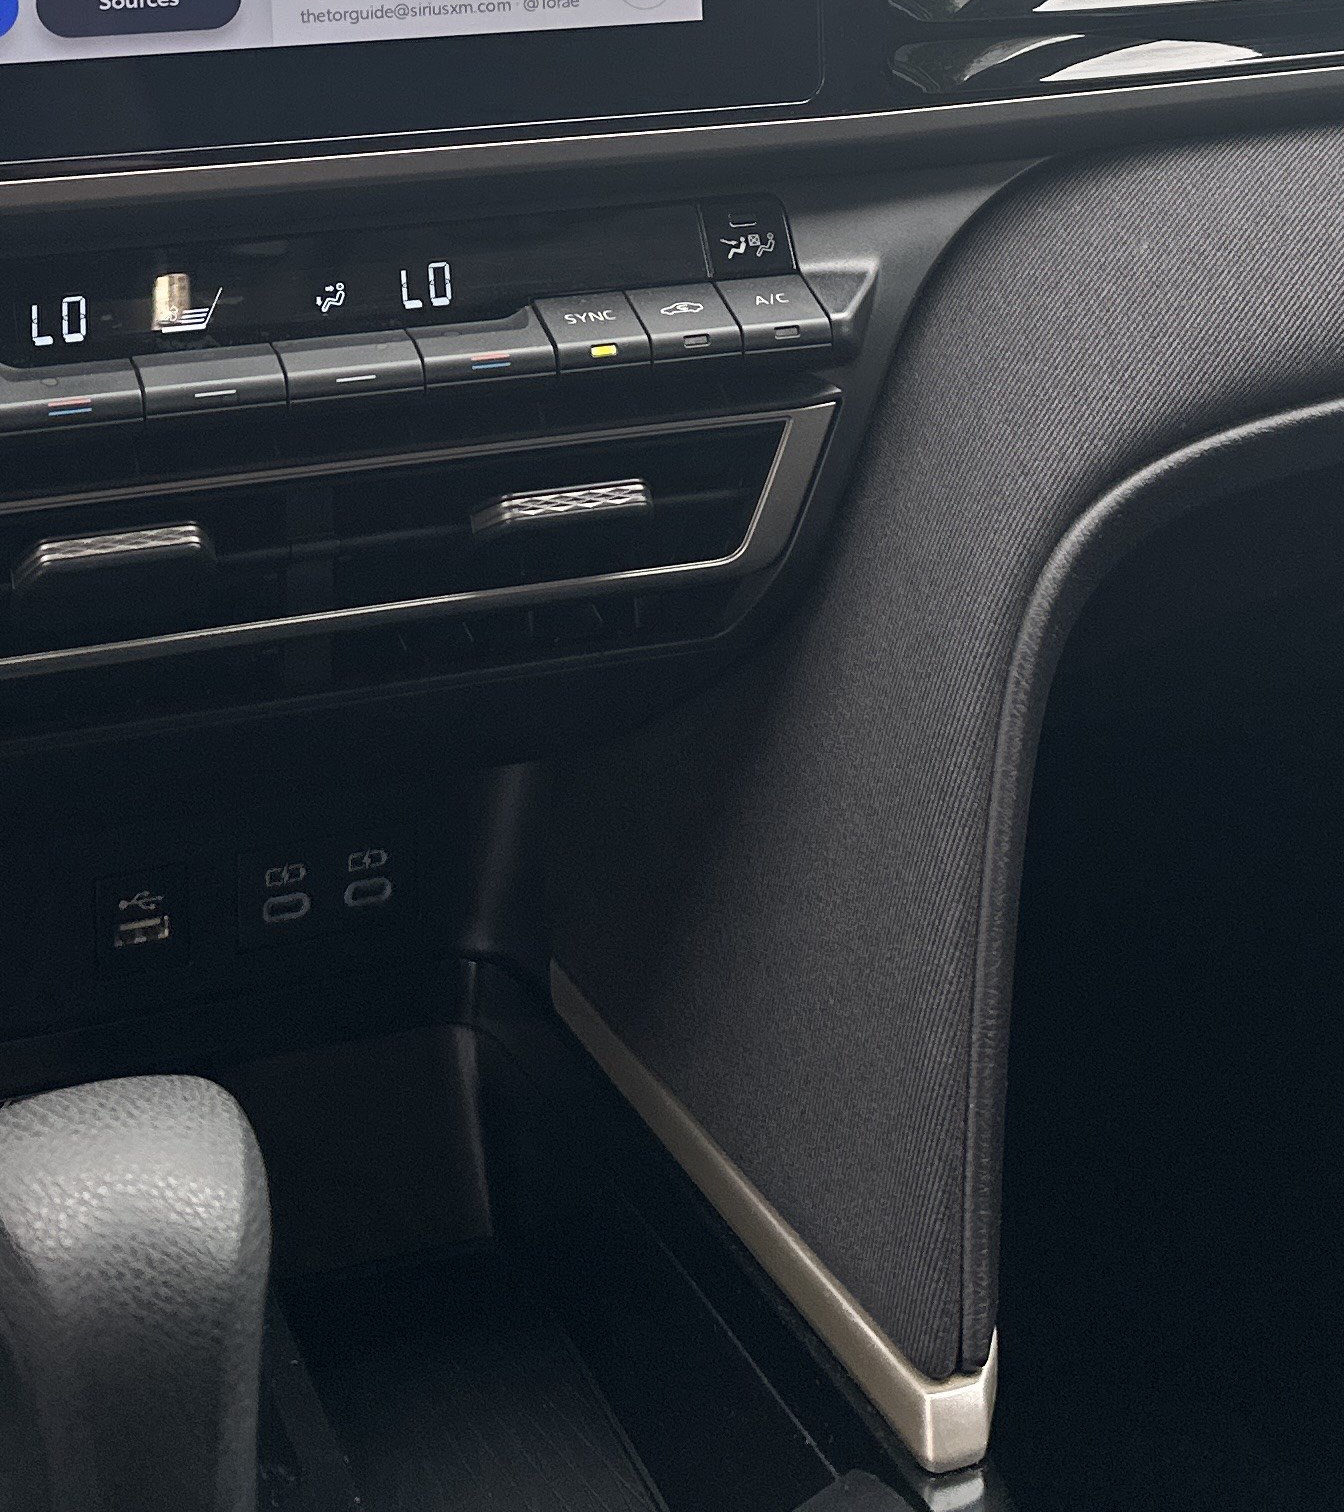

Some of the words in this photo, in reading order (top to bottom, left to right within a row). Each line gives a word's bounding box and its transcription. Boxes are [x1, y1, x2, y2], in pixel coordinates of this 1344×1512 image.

[300, 0, 512, 24] thetorguide@siriusxm.com
[755, 292, 790, 306] A/C
[563, 309, 617, 325] SYNC
